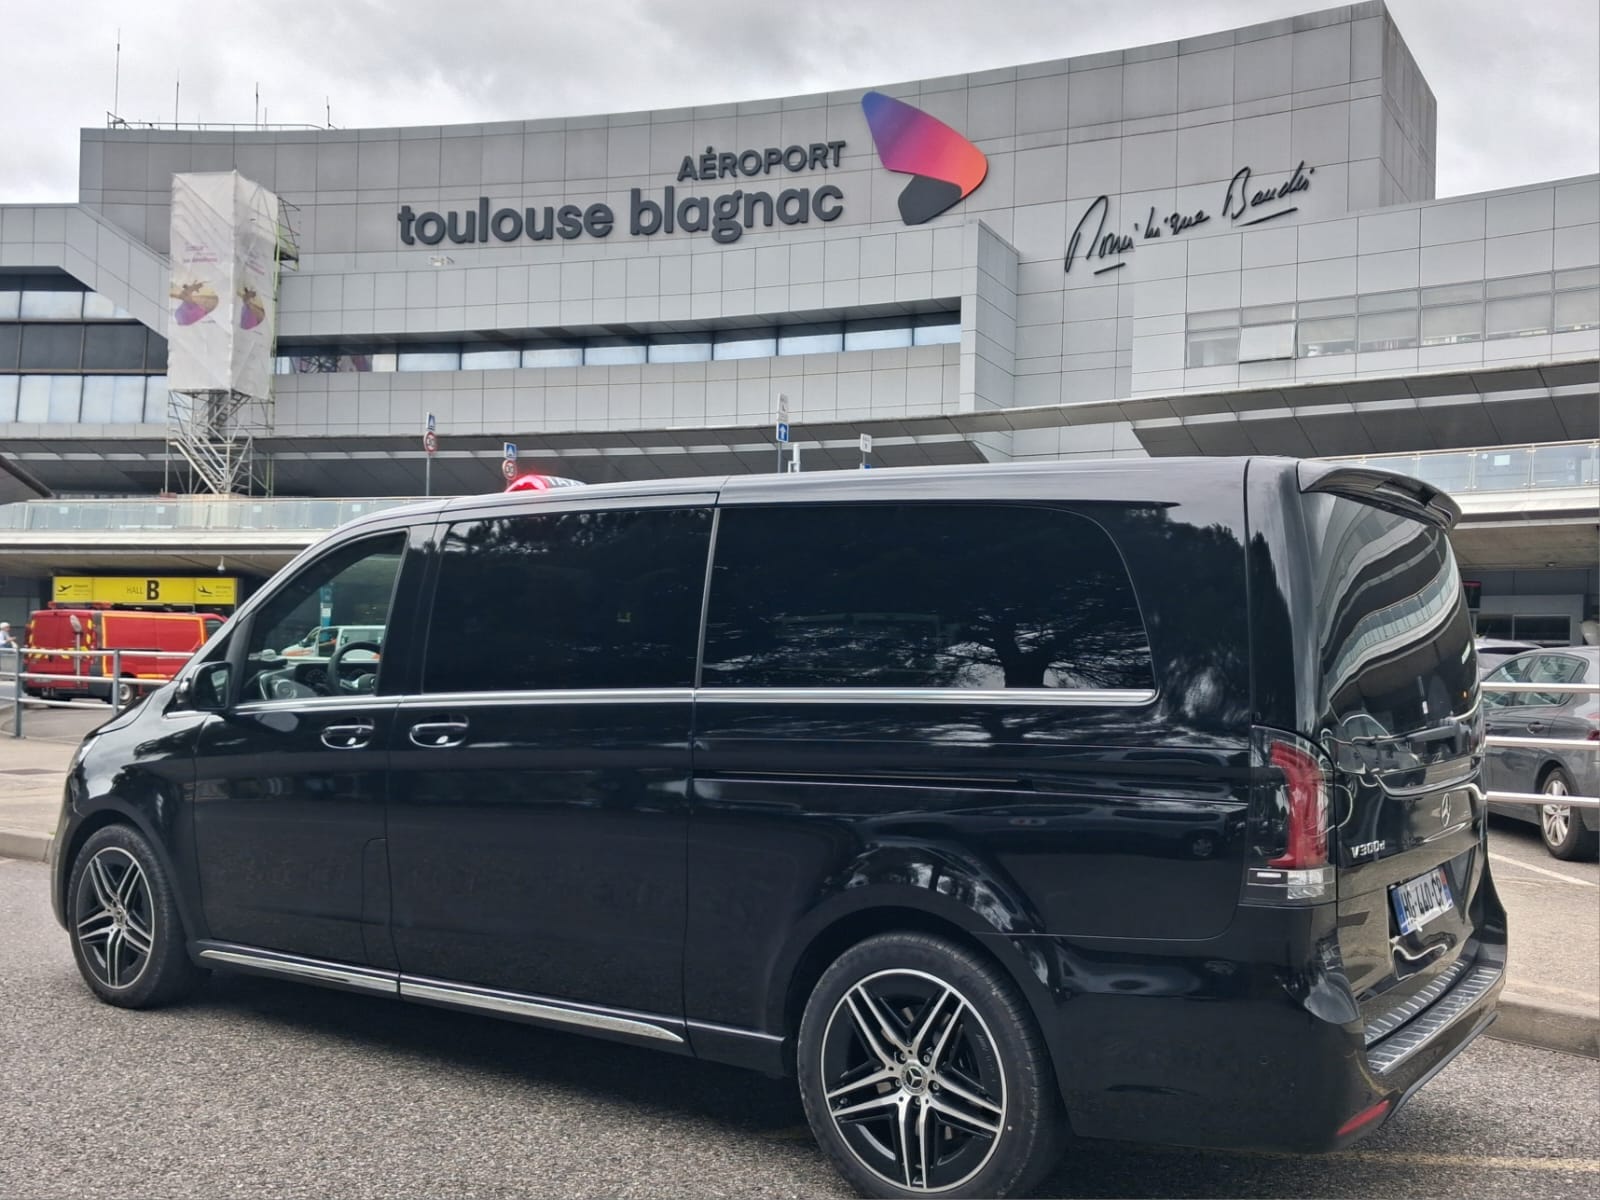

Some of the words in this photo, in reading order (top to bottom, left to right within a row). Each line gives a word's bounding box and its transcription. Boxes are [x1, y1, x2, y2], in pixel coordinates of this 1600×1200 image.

[676, 140, 847, 182] AÉROPORT
[397, 196, 615, 246] toulouse
[629, 184, 845, 244] blagnac
[146, 579, 160, 601] B
